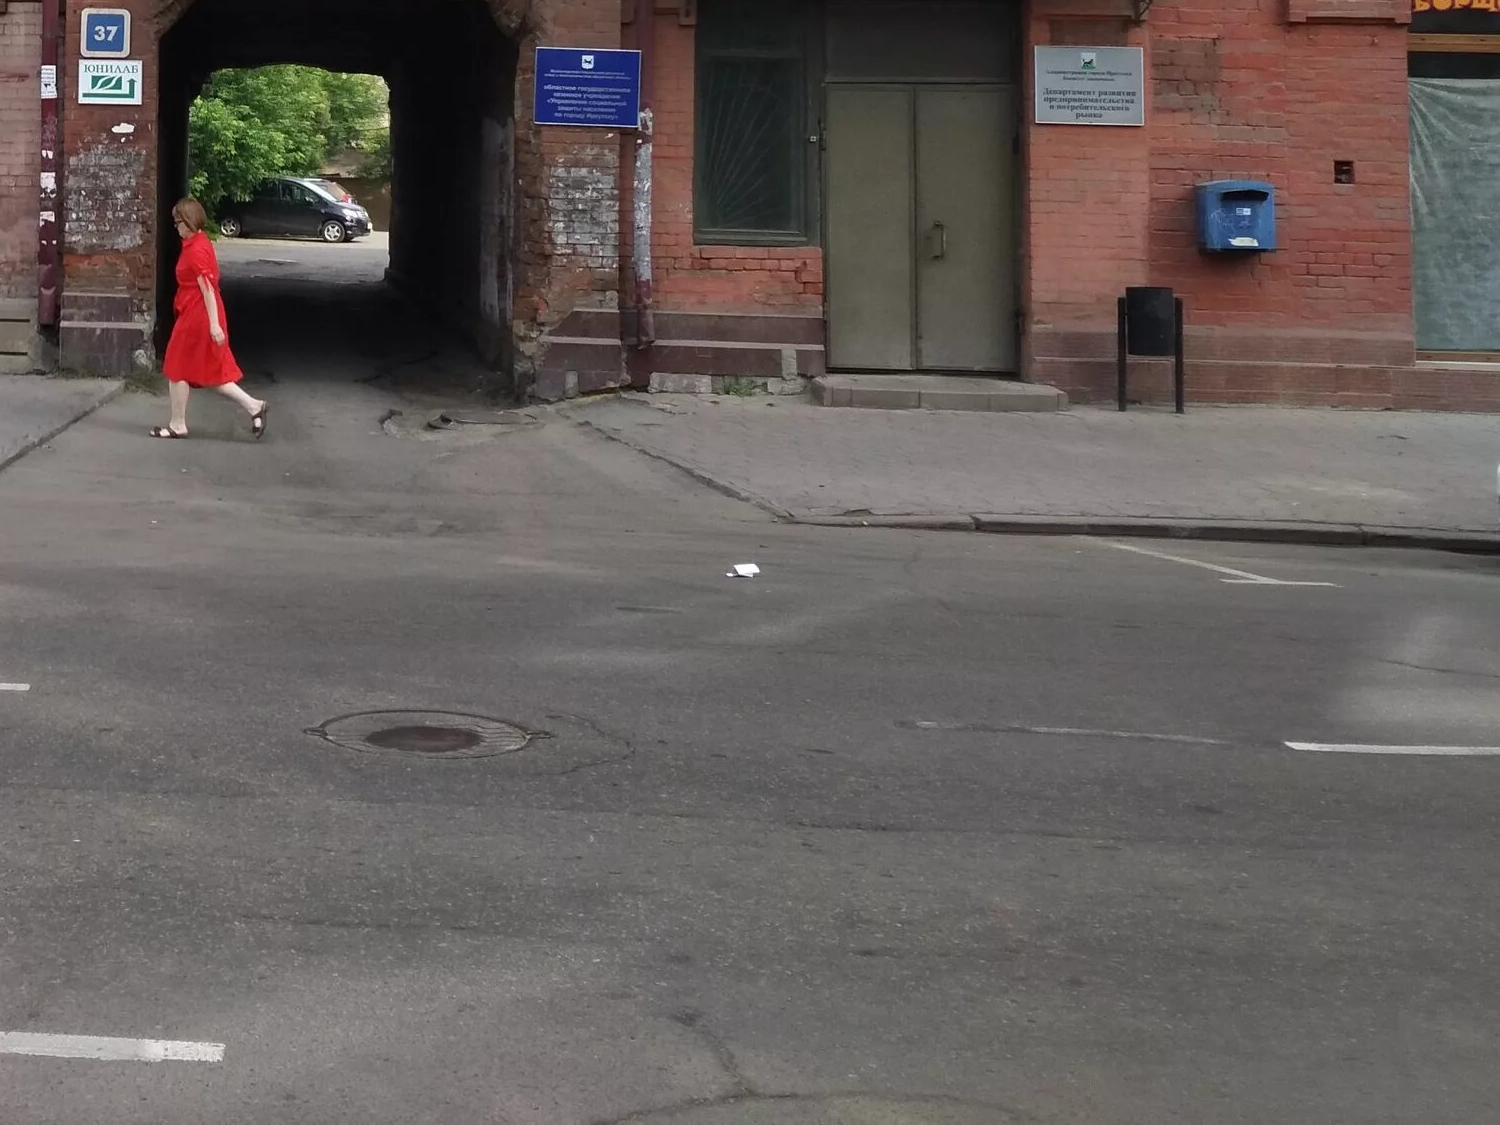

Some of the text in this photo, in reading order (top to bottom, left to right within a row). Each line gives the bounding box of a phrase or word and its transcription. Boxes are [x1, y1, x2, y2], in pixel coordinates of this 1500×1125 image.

[94, 25, 118, 42] 37
[83, 64, 139, 74] ЮНИЛАБ
[1042, 88, 1137, 98] Департамент развития
[1043, 96, 1135, 105] предпринимательства
